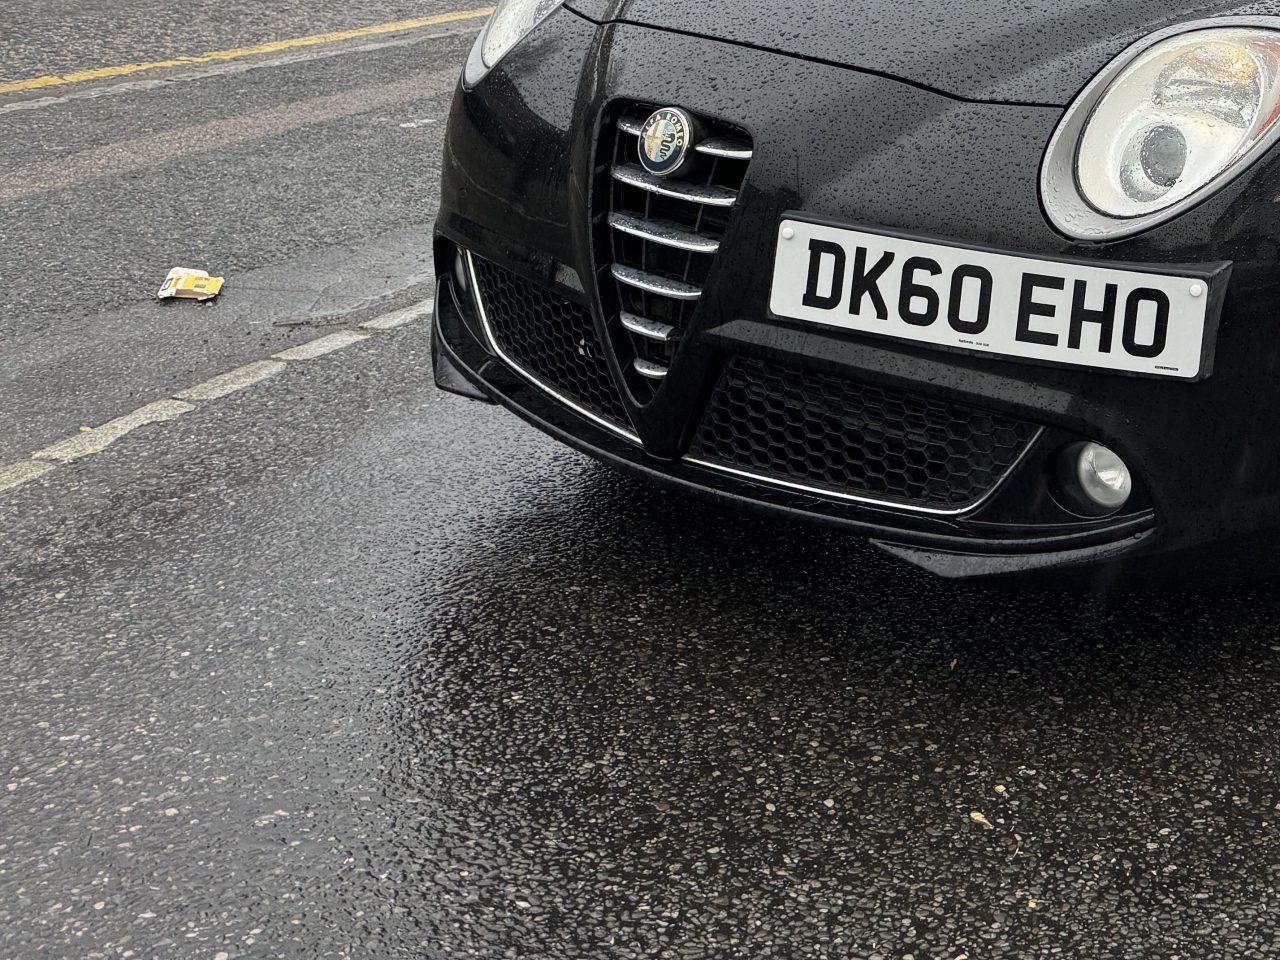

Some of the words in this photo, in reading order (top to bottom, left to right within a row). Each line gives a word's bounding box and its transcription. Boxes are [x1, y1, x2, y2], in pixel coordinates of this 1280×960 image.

[665, 112, 684, 146] ROMEO
[801, 237, 994, 336] DK60
[1015, 271, 1171, 359] EHO
